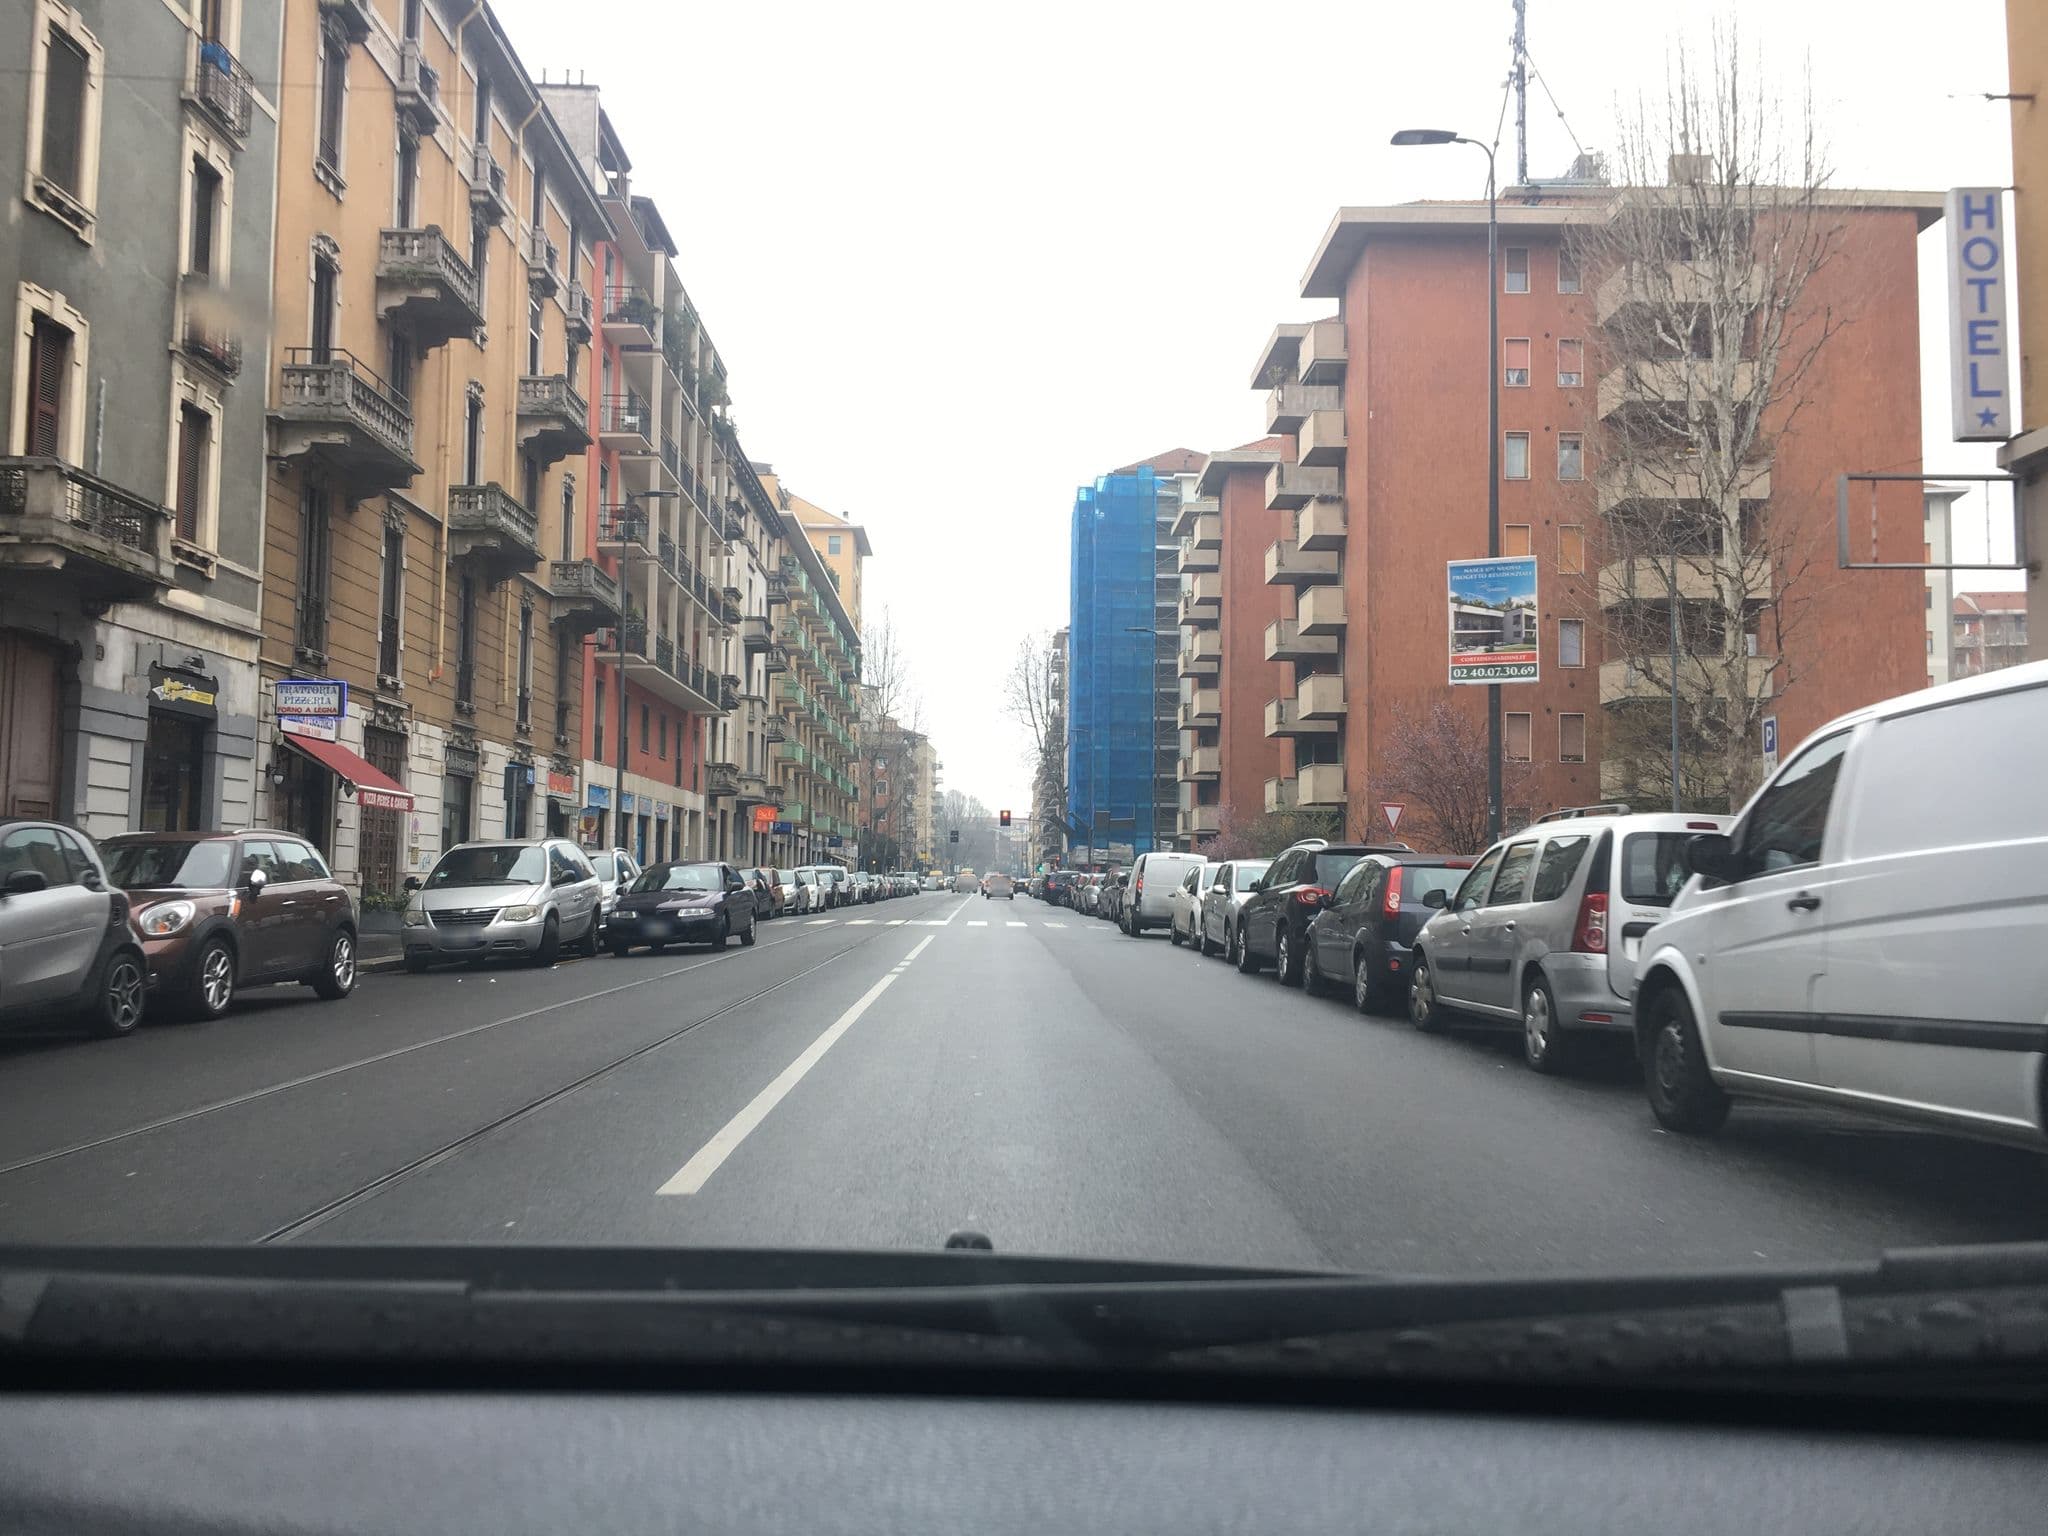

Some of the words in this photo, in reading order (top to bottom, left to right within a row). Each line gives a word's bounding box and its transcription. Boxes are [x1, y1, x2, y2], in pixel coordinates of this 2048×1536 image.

[1962, 194, 2003, 397] HOTEL
[1452, 573, 1487, 581] PROGETTO
[1453, 668, 1468, 678] 02
[1470, 665, 1535, 677] 40.07.30.69
[279, 685, 337, 695] TRATTORIA
[284, 696, 332, 705] PIZZERIA
[1766, 726, 1773, 748] P
